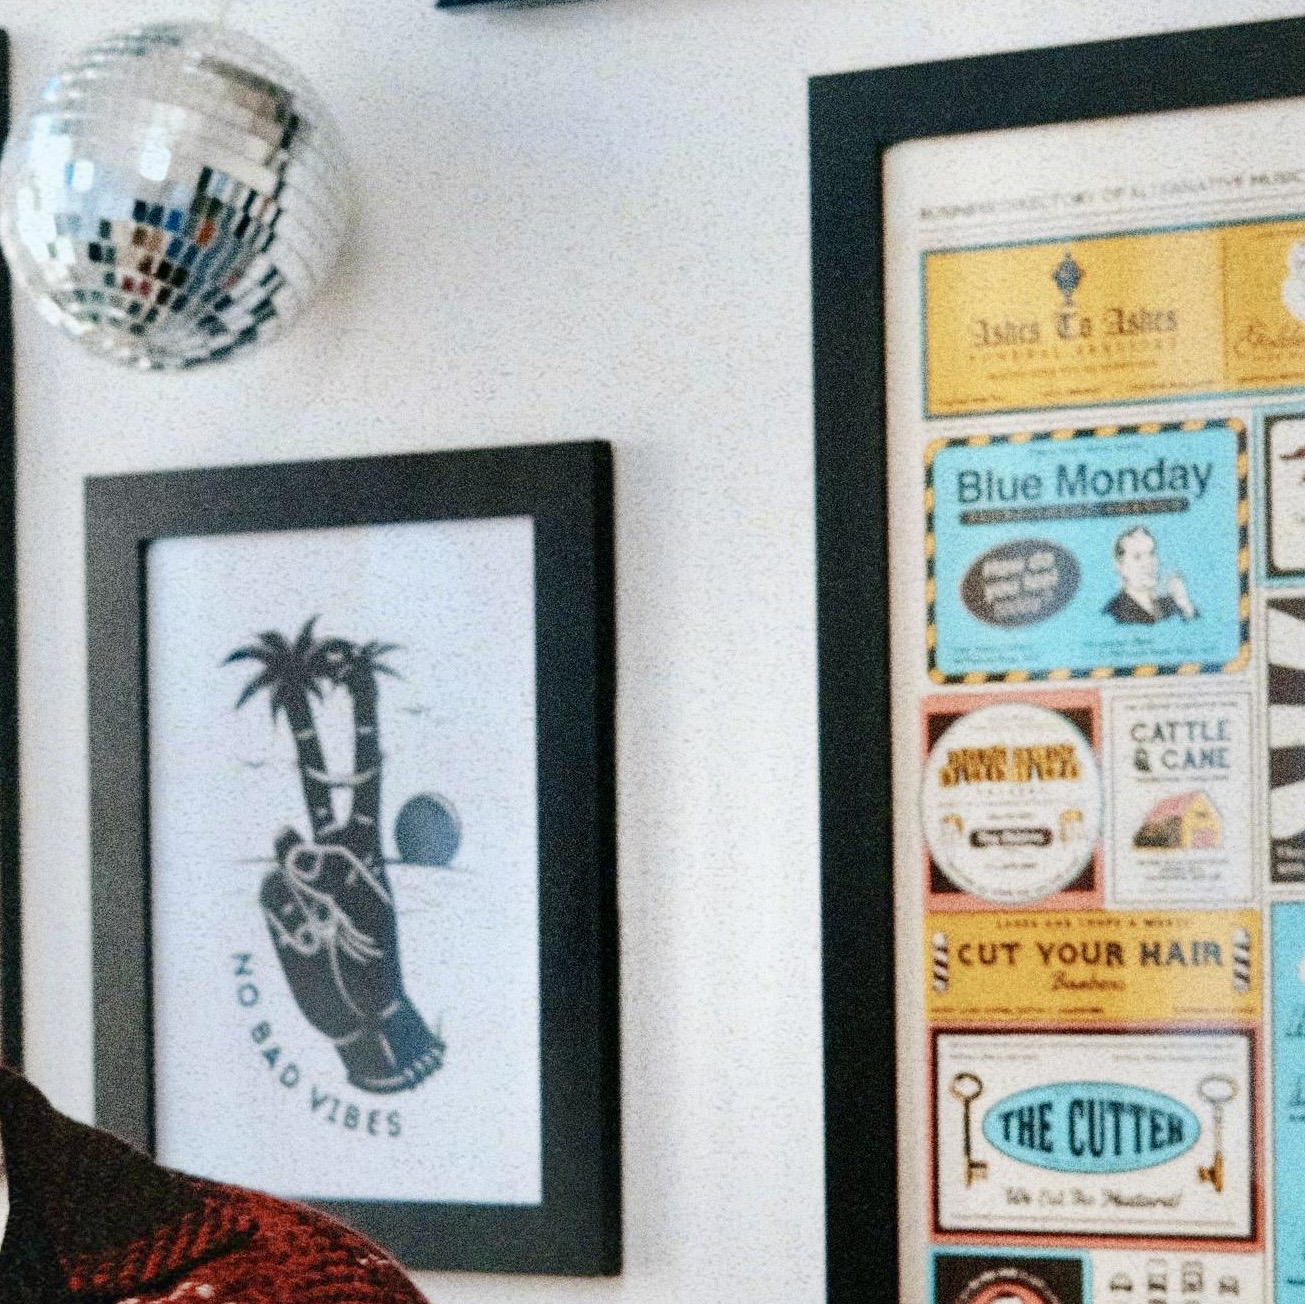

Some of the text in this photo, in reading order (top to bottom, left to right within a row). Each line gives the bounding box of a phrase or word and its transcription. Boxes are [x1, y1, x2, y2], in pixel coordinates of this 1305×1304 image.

[968, 307, 1178, 348] Ashes To Ashes
[956, 456, 1214, 503] Blue Monday
[1130, 717, 1232, 743] CATTLE
[1133, 747, 1231, 773] & CANE
[956, 939, 1224, 968] CUT YOUR HAIR
[231, 951, 402, 1138] NO BAD VIBES
[999, 1098, 1185, 1158] THE CUTTER
